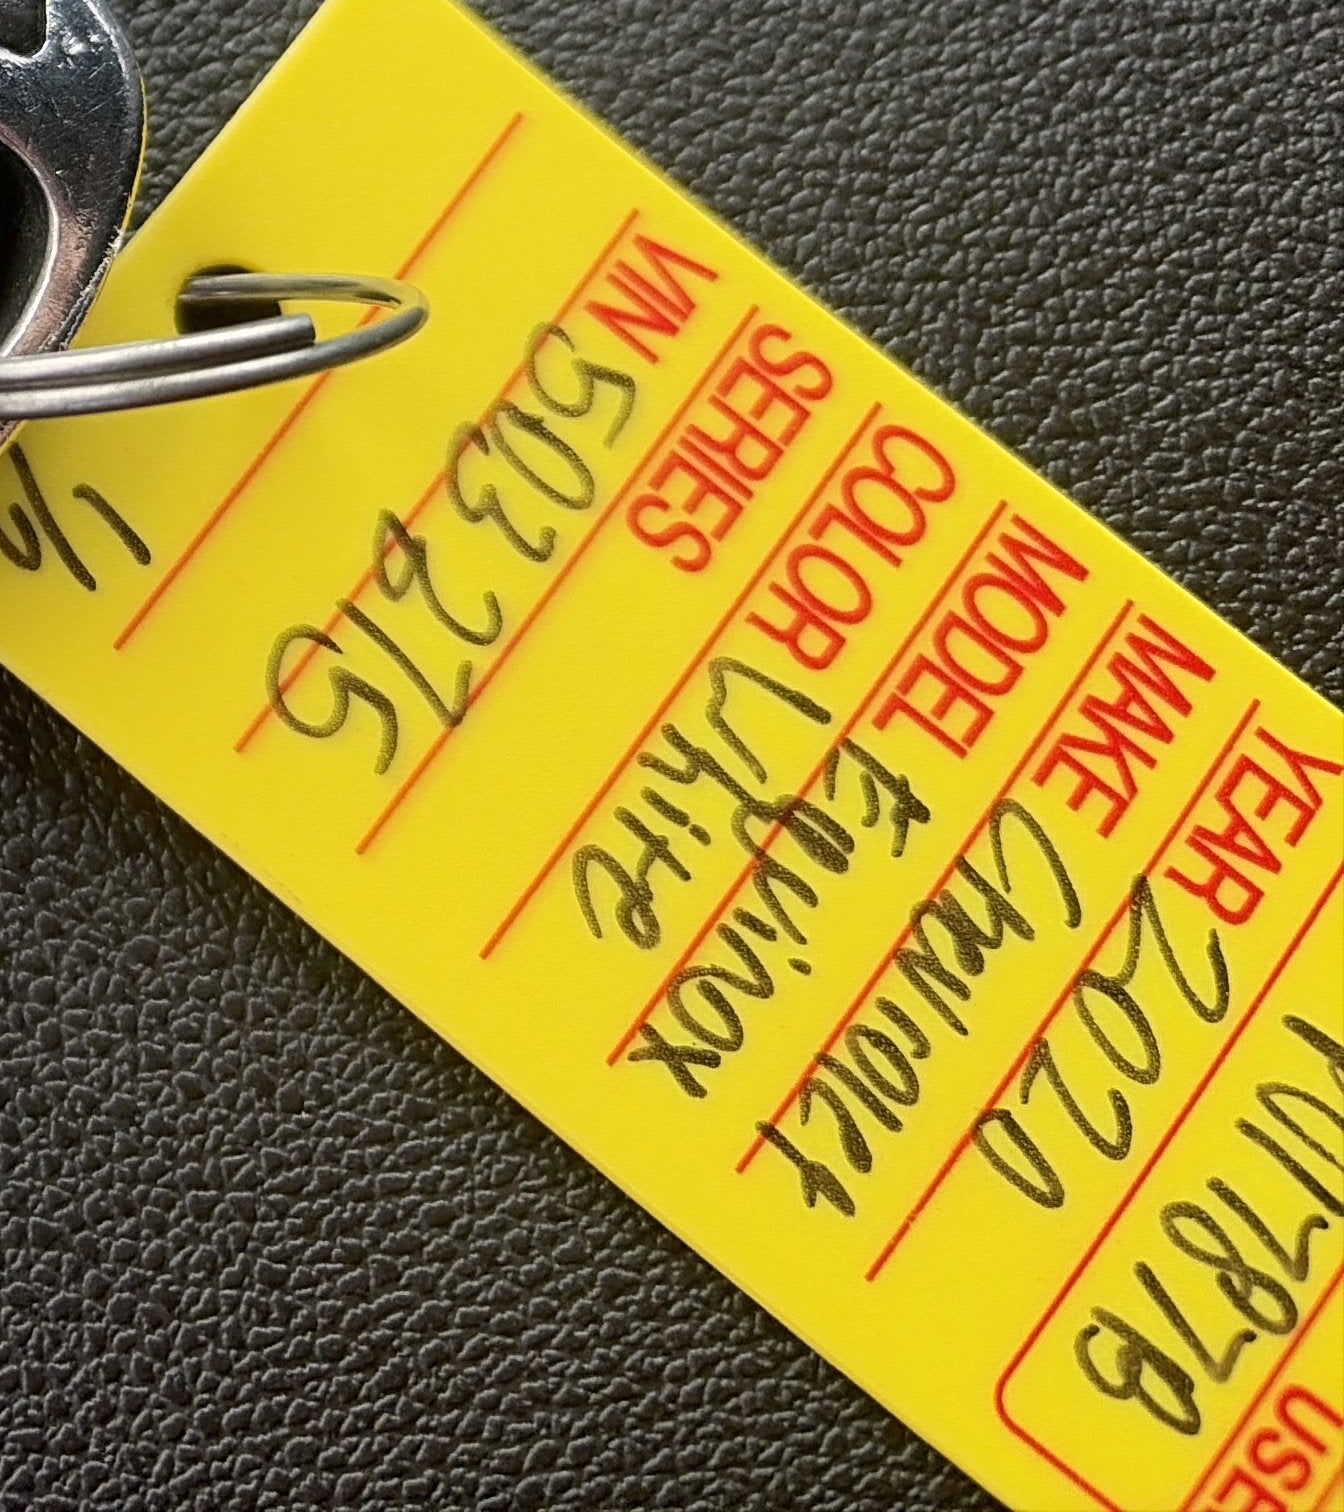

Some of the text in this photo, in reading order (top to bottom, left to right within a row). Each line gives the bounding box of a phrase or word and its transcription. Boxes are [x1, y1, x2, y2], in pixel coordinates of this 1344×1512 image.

[584, 234, 719, 364] VIN
[625, 324, 833, 574] SERIES
[745, 424, 956, 672] COLOR
[872, 513, 1090, 759] MODEL
[1031, 613, 1216, 840] MAKE
[572, 655, 832, 950] White
[1162, 726, 1344, 927] YEAR
[970, 872, 1229, 1210] 2020
